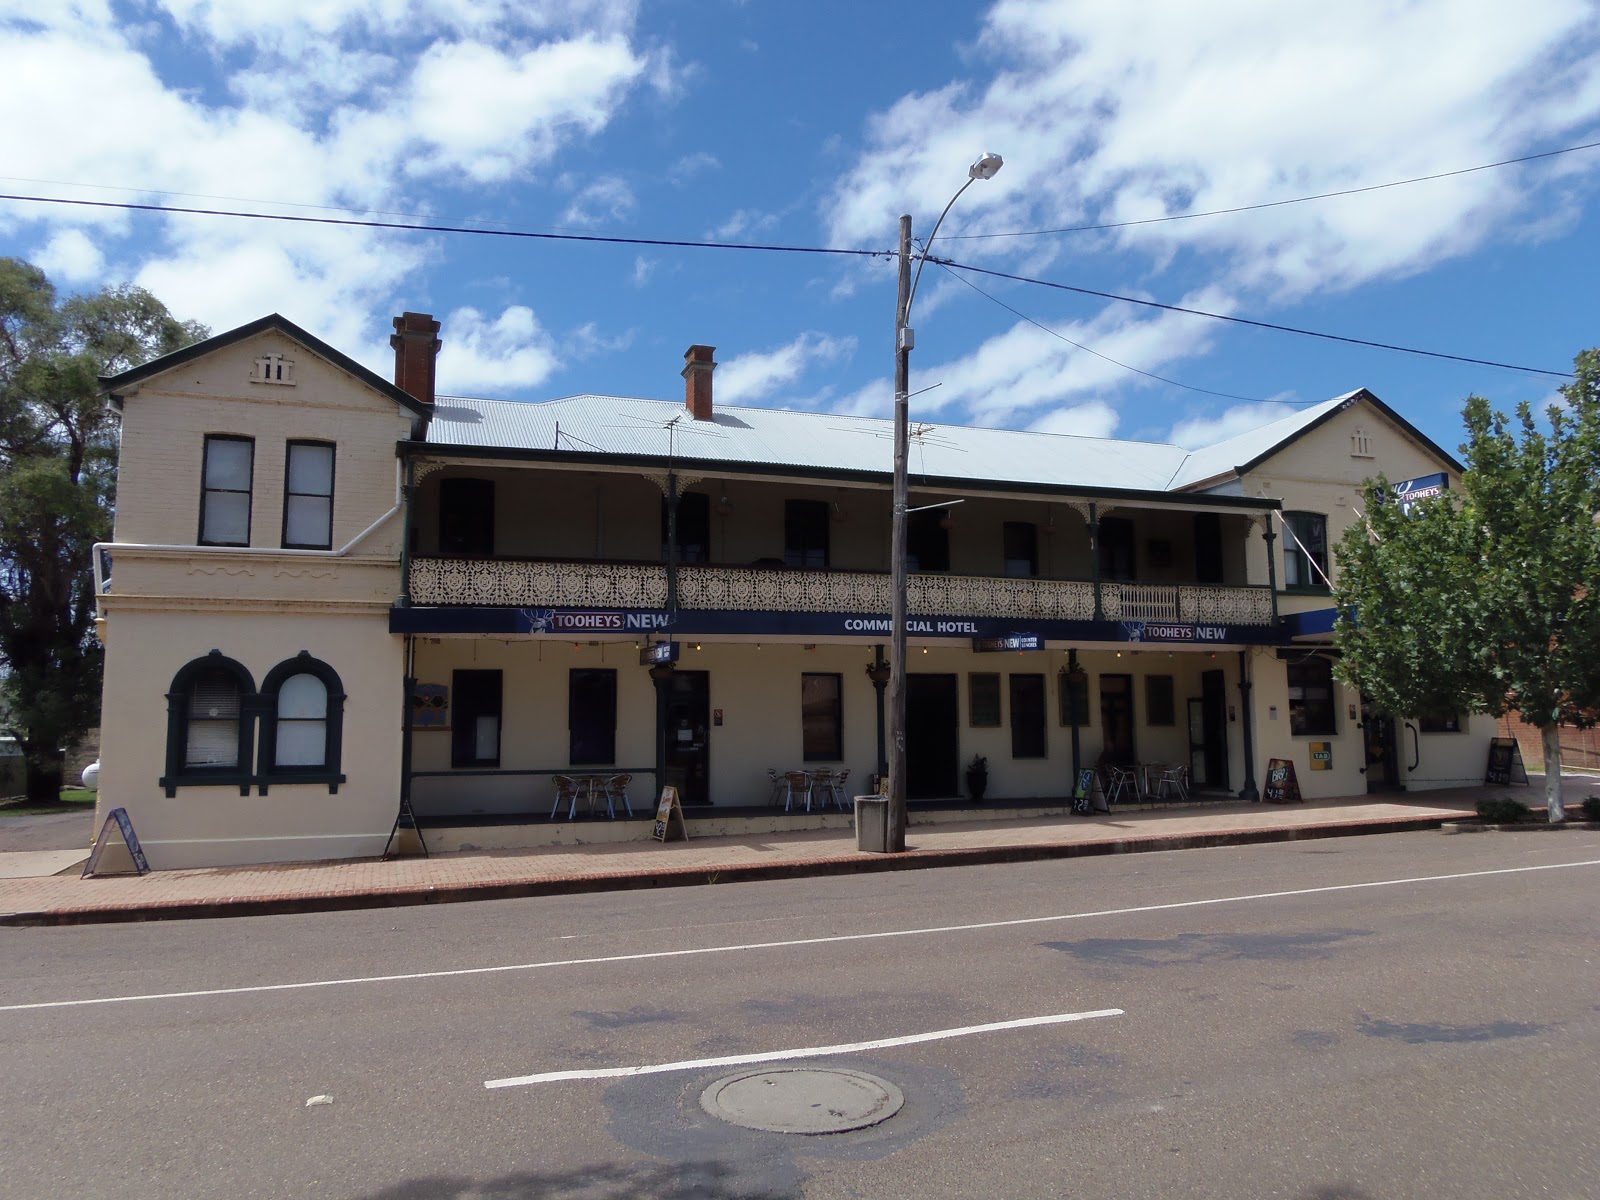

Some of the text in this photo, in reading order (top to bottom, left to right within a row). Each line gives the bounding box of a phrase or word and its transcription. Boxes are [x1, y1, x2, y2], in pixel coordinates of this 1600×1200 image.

[1405, 487, 1439, 501] TOOHEYS
[555, 614, 669, 628] TOOHEYS NEW
[844, 619, 978, 633] COMMECIAL HOTEL
[1146, 626, 1226, 640] TOOHEYS NEW
[1004, 638, 1020, 649] NEW
